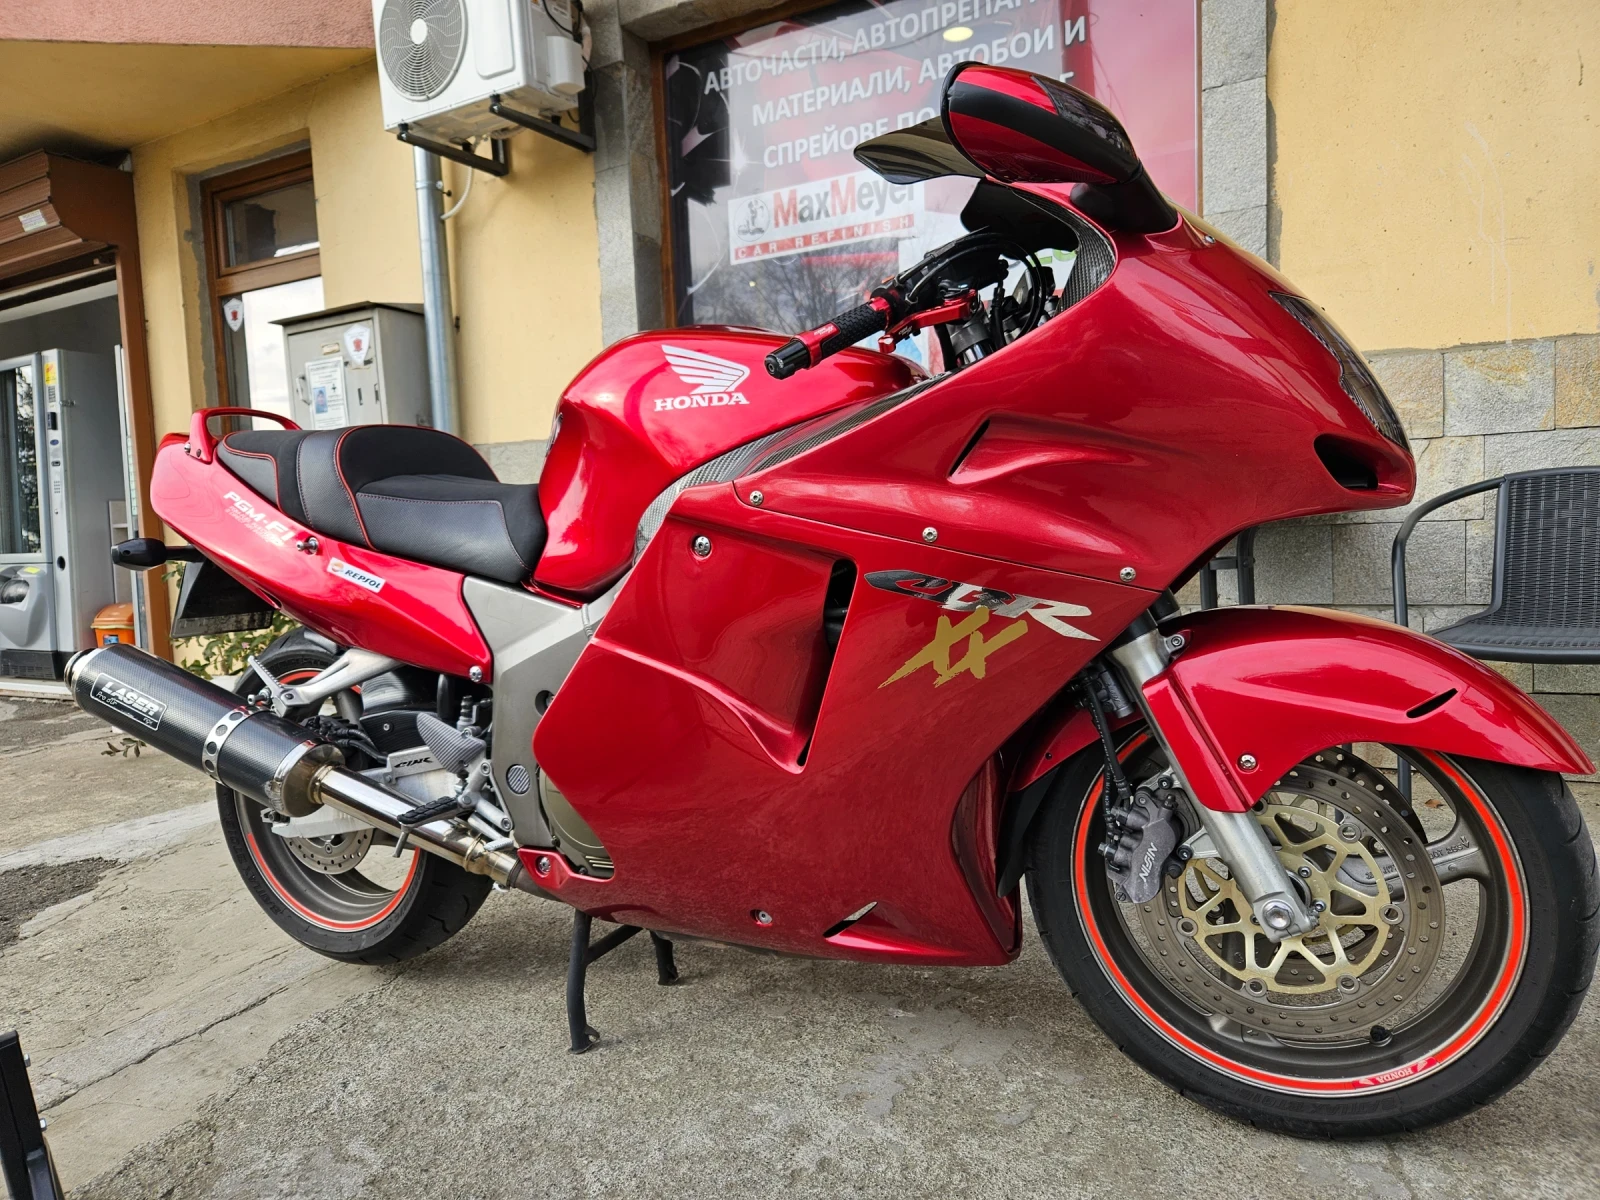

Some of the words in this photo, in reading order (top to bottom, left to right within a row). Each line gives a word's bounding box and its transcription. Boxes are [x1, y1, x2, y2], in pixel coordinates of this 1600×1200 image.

[703, 36, 846, 95] АВТОЧАСТИ,
[752, 65, 911, 126] МАТЕРИАЛИ,
[1064, 15, 1086, 46] И
[763, 117, 889, 168] СПРЕЙОВЕ
[737, 245, 778, 259] CAR
[795, 218, 911, 248] REFINISH
[654, 392, 750, 412] HONDA
[344, 569, 381, 590] REPSOL
[864, 569, 1102, 642] CBR
[877, 605, 1029, 689] XX
[101, 681, 160, 716] LASER
[1375, 1067, 1414, 1083] HONDA
